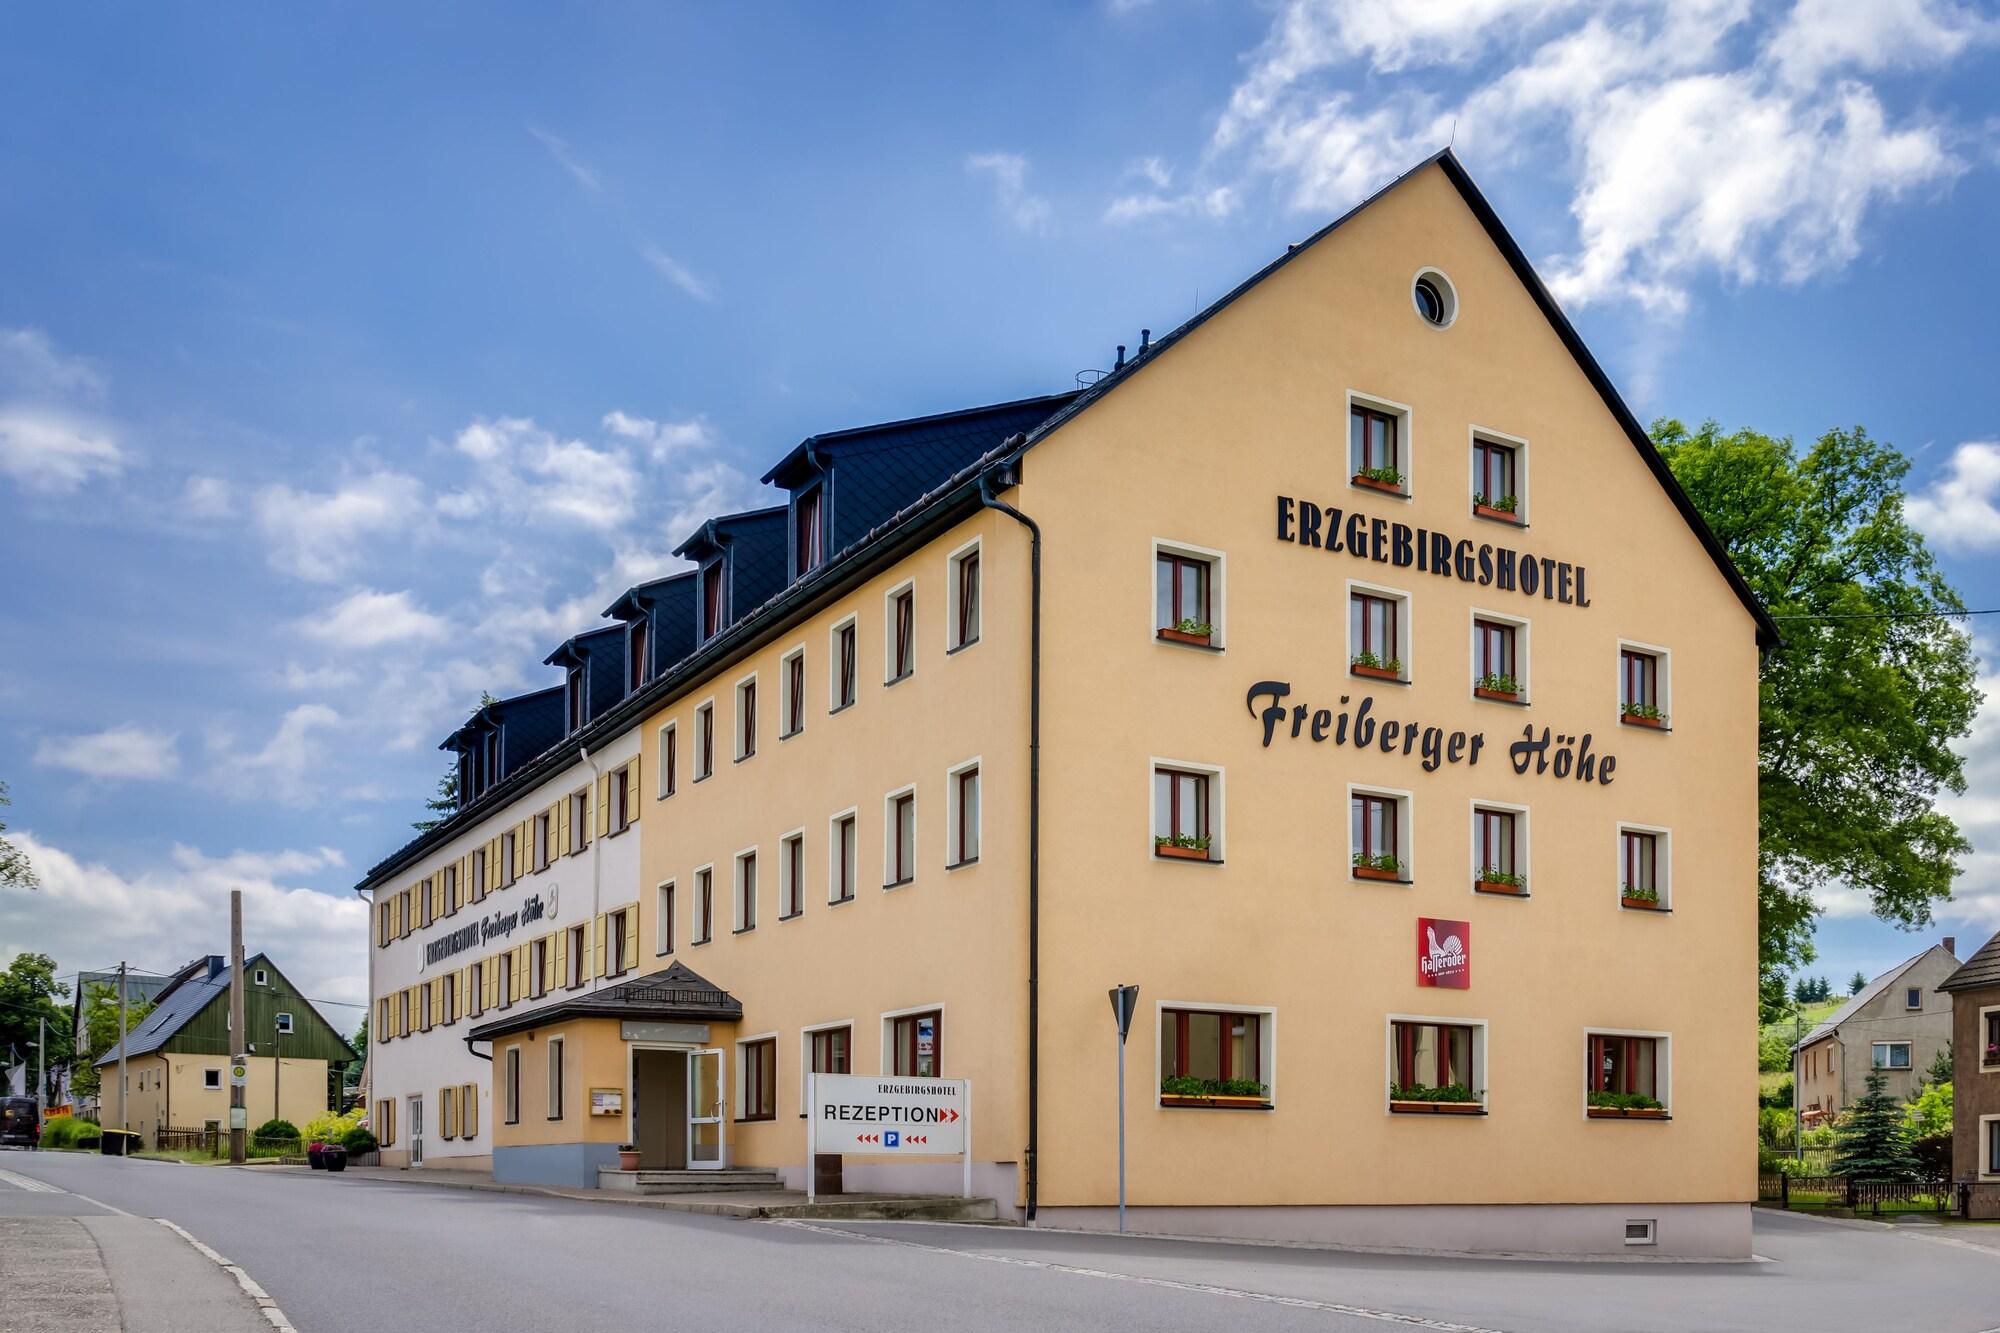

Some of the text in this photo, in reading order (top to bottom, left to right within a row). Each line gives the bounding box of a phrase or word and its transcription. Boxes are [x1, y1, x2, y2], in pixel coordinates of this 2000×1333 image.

[1277, 495, 1591, 608] ERZGEBIRGSHOTEL
[1247, 681, 1617, 786] Freiberger Höhe
[426, 921, 480, 966] ERZGEBIRGSHOTEL
[878, 1084, 957, 1096] ERZGEBIRGSHOTEL
[824, 1104, 939, 1123] REZEPTION
[887, 1133, 897, 1145] P
